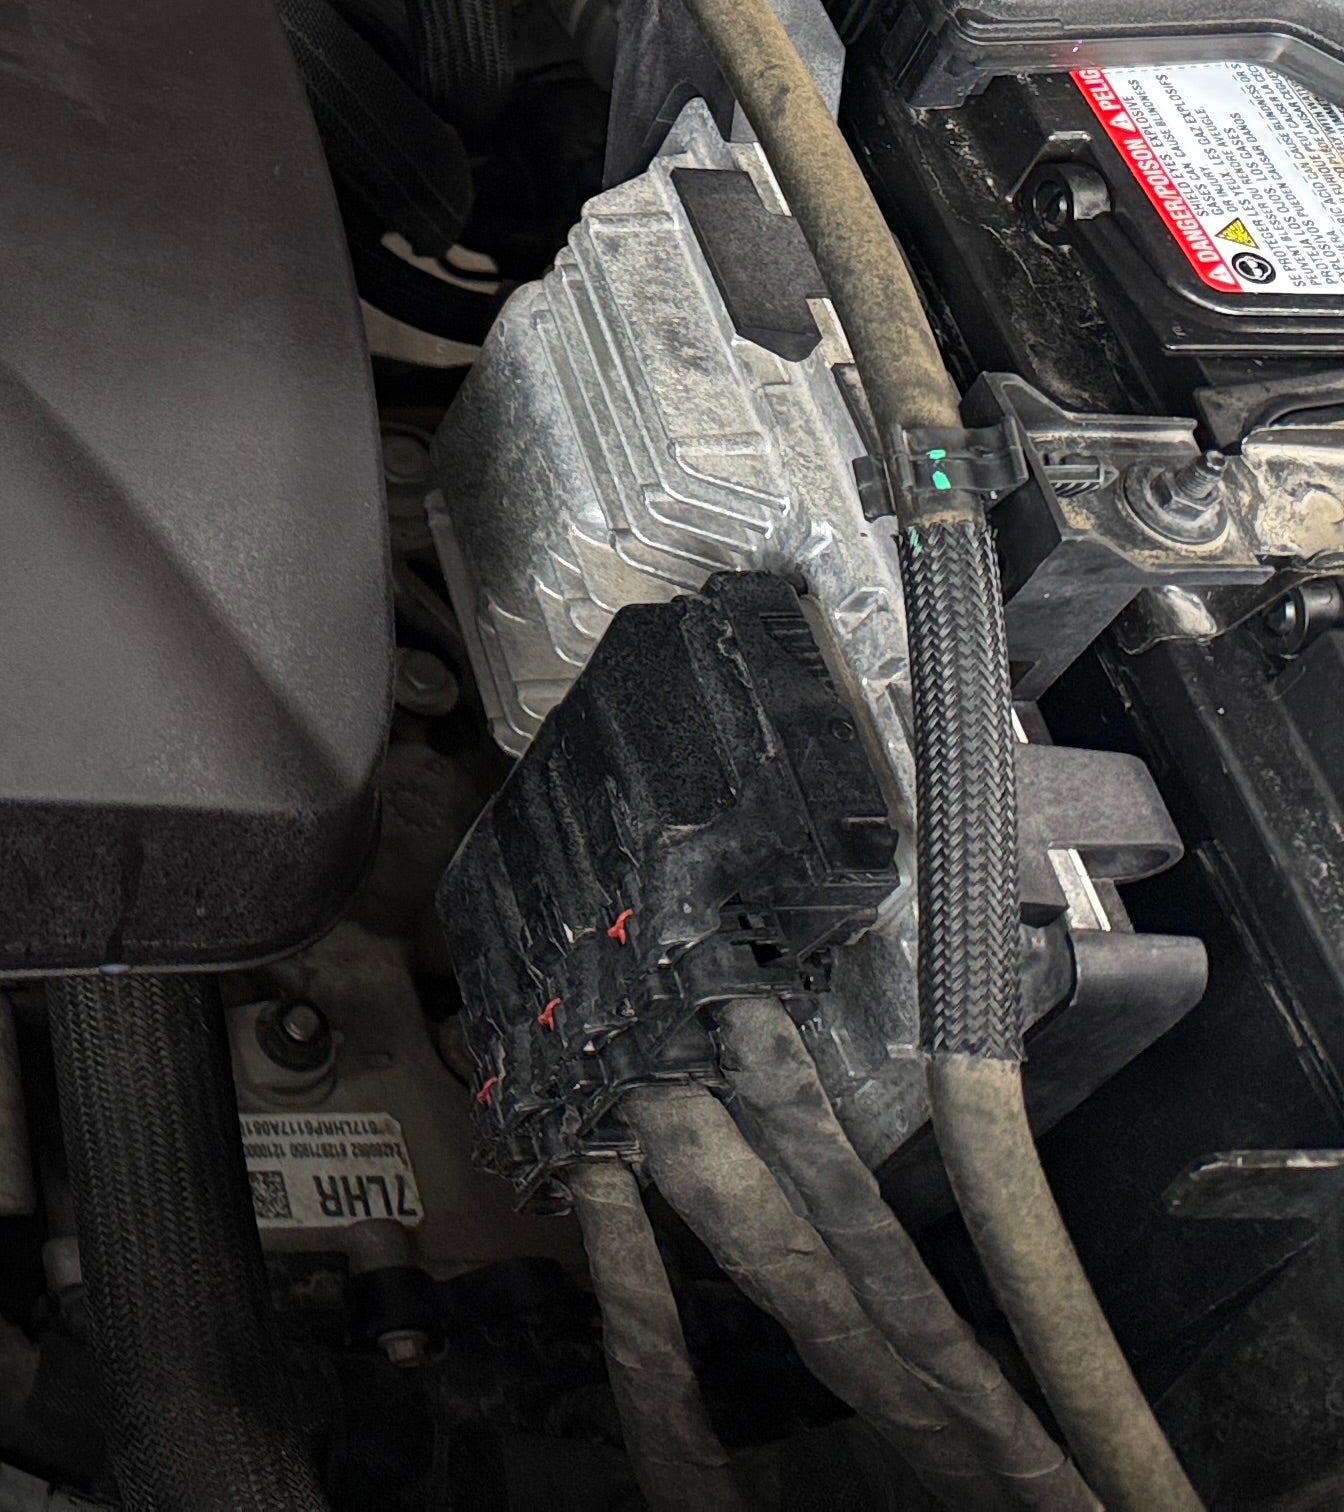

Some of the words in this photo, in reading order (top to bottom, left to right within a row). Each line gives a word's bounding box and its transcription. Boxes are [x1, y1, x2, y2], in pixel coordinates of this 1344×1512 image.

[1234, 71, 1251, 82] OR
[1258, 83, 1275, 94] LA
[1125, 79, 1168, 126] BLINDNESS
[1153, 74, 1198, 123] EXPLOSIFS
[1243, 84, 1285, 129] BLINDNESS
[1267, 96, 1300, 128] CAUSER
[1120, 95, 1165, 146] EXPLOSIVE
[1190, 105, 1230, 147] AVEUGLE.
[1225, 112, 1259, 142] DAÑOS
[1286, 101, 1320, 134] CAUSAR
[1312, 111, 1337, 134] WITH
[1156, 128, 1188, 157] CAUSE
[1187, 126, 1213, 144] GAZ
[1220, 127, 1255, 158] GASES
[1277, 132, 1306, 159] CAUSE
[1291, 130, 1317, 151] PEUT
[1311, 136, 1341, 164] PUEDE
[1155, 151, 1186, 178] EYES.
[1179, 162, 1202, 180] CAN
[1201, 147, 1226, 165] LES
[1219, 149, 1254, 184] RENDRE
[1243, 161, 1269, 181] LOS
[1249, 145, 1284, 179] CAUSAR
[1297, 162, 1320, 179] CAN
[1195, 163, 1230, 196] INJURY.
[1214, 168, 1246, 196] YEUX.
[1245, 187, 1265, 199] OU
[1309, 181, 1337, 203] ACID
[1121, 138, 1221, 262] DANGER/POISON
[1173, 181, 1211, 216] SHIELD
[1192, 183, 1226, 215] GASES
[1220, 199, 1239, 211] OR
[1235, 198, 1260, 216] LES
[1258, 183, 1291, 212] OJOS.
[1275, 182, 1310, 217] PUEDEN
[1255, 201, 1293, 241] BLESSER
[1280, 216, 1306, 235] LOS
[1247, 219, 1298, 271] PROTÉGER
[1299, 219, 1344, 282] XPLOSIVOS
[1284, 244, 1324, 285] PEUVENT
[1296, 238, 1340, 283] PROTEJA
[1286, 274, 1308, 286] SE
[312, 1175, 417, 1217] 7LHR
